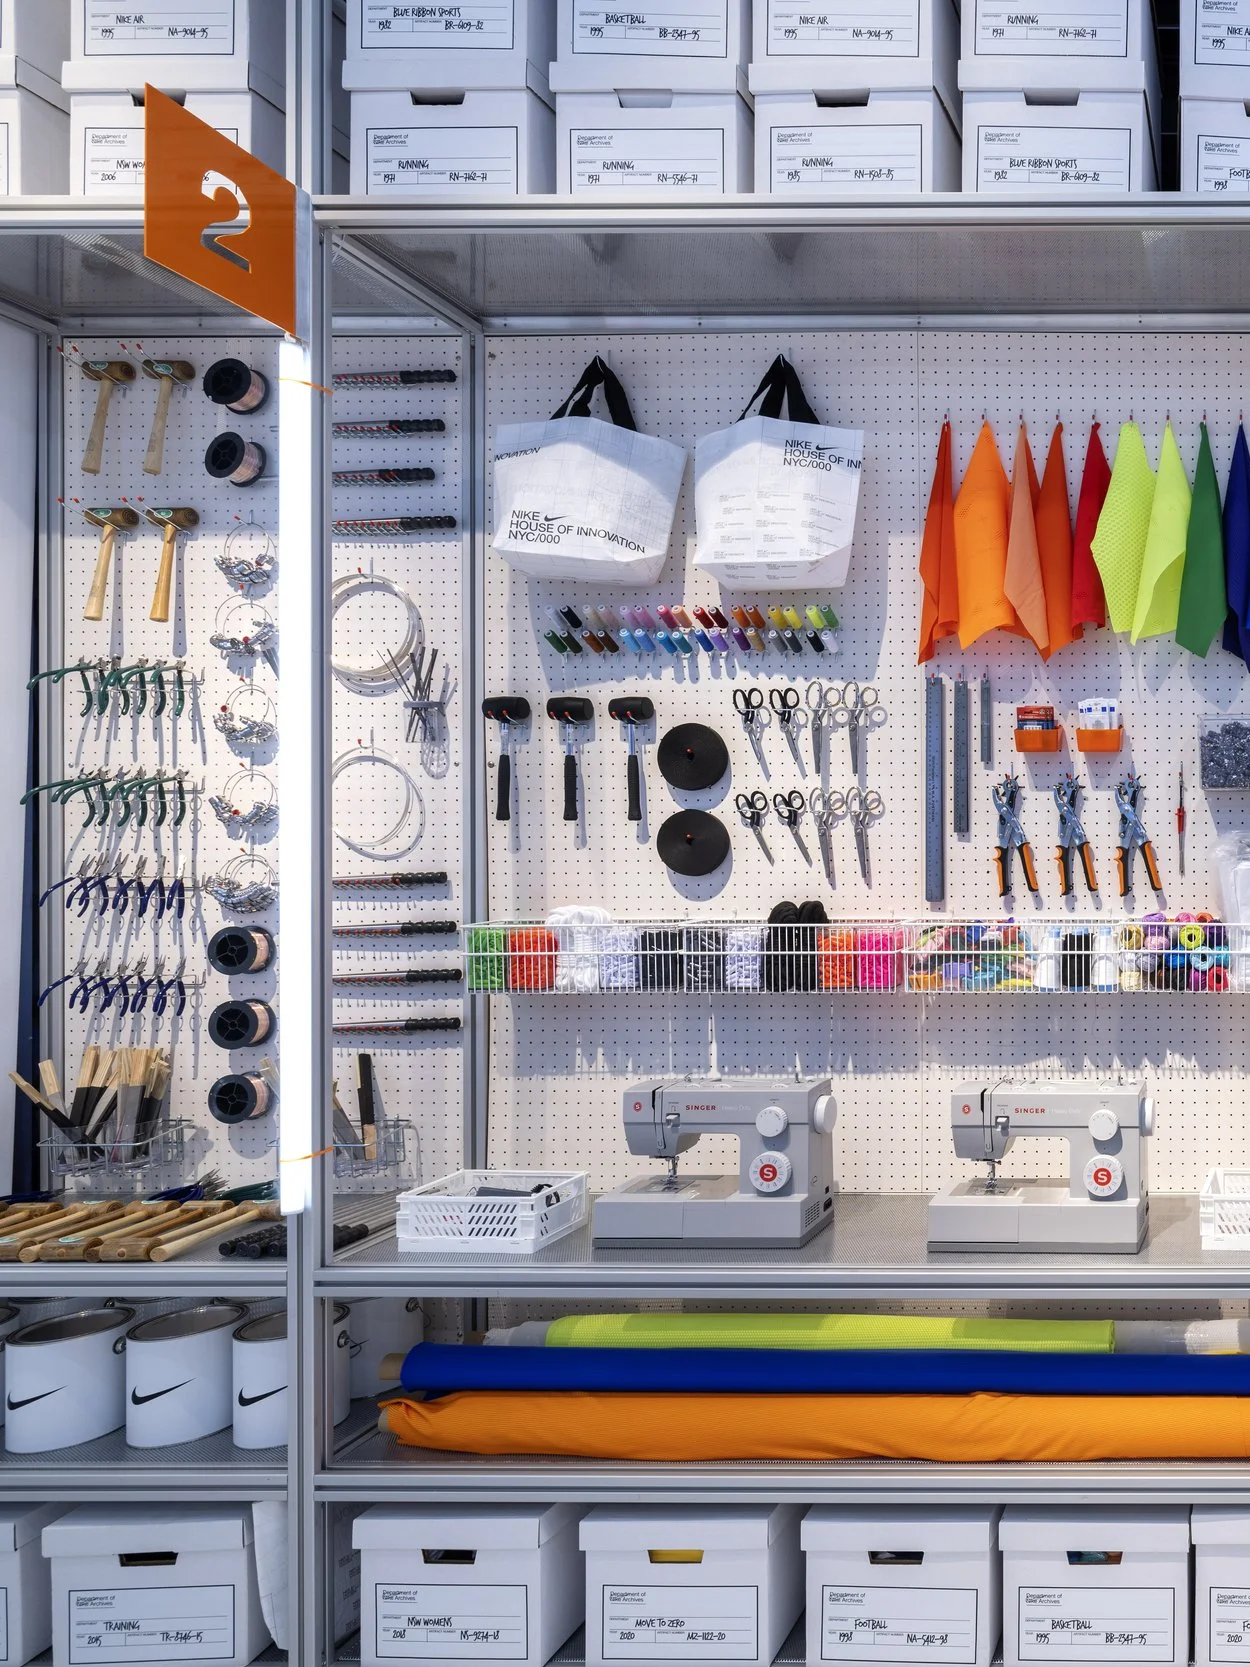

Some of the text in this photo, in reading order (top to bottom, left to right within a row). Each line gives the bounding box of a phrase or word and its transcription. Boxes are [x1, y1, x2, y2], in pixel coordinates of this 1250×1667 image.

[393, 7, 461, 18] BLUE RIBBON SPORTS
[116, 15, 145, 24] NIKE AIR
[378, 20, 391, 30] 1982
[605, 14, 646, 25] BASKETBALL
[799, 16, 829, 25] NIKE AIR
[1007, 15, 1039, 25] RUNNING
[100, 28, 114, 39] 1995
[590, 26, 604, 38] 1995
[784, 28, 798, 40] 1995
[992, 28, 1004, 38] 1971
[1227, 26, 1243, 36] NIKE
[1211, 38, 1226, 50] 1995
[398, 159, 429, 170] RUNNING
[602, 160, 634, 171] RUNNING
[801, 157, 833, 168] RUNNING
[1009, 158, 1078, 169] BLUE RIBBON SPORTS
[101, 173, 116, 182] 2006
[383, 173, 396, 183] 1971
[587, 174, 600, 184] 1971
[787, 170, 801, 182] 1985
[994, 170, 1008, 180] 1982
[1213, 180, 1228, 190] 1998
[200, 170, 251, 273] 2
[785, 439, 812, 450] NIKE
[784, 449, 825, 461] HOUSE
[828, 454, 844, 465] OF
[783, 457, 832, 472] NYC/000
[511, 509, 540, 521] NIKE
[508, 530, 561, 544] NYC/000
[510, 520, 646, 553] HOUSE OF INNOVATION
[763, 1167, 774, 1179] S
[1097, 1171, 1108, 1183] S
[103, 1620, 140, 1631] TRAINING
[407, 1616, 452, 1627] NSW WOMENS
[635, 1619, 685, 1629] MOVE TO ZERO
[854, 1619, 888, 1630] FOOTBALL
[1051, 1619, 1092, 1630] BASKETBALL
[392, 1629, 406, 1639] 2018
[619, 1631, 635, 1641] 2020
[838, 1632, 853, 1642] 1998
[1035, 1633, 1050, 1644] 1995
[1227, 1633, 1242, 1643] 2020
[87, 1635, 102, 1647] 2015
